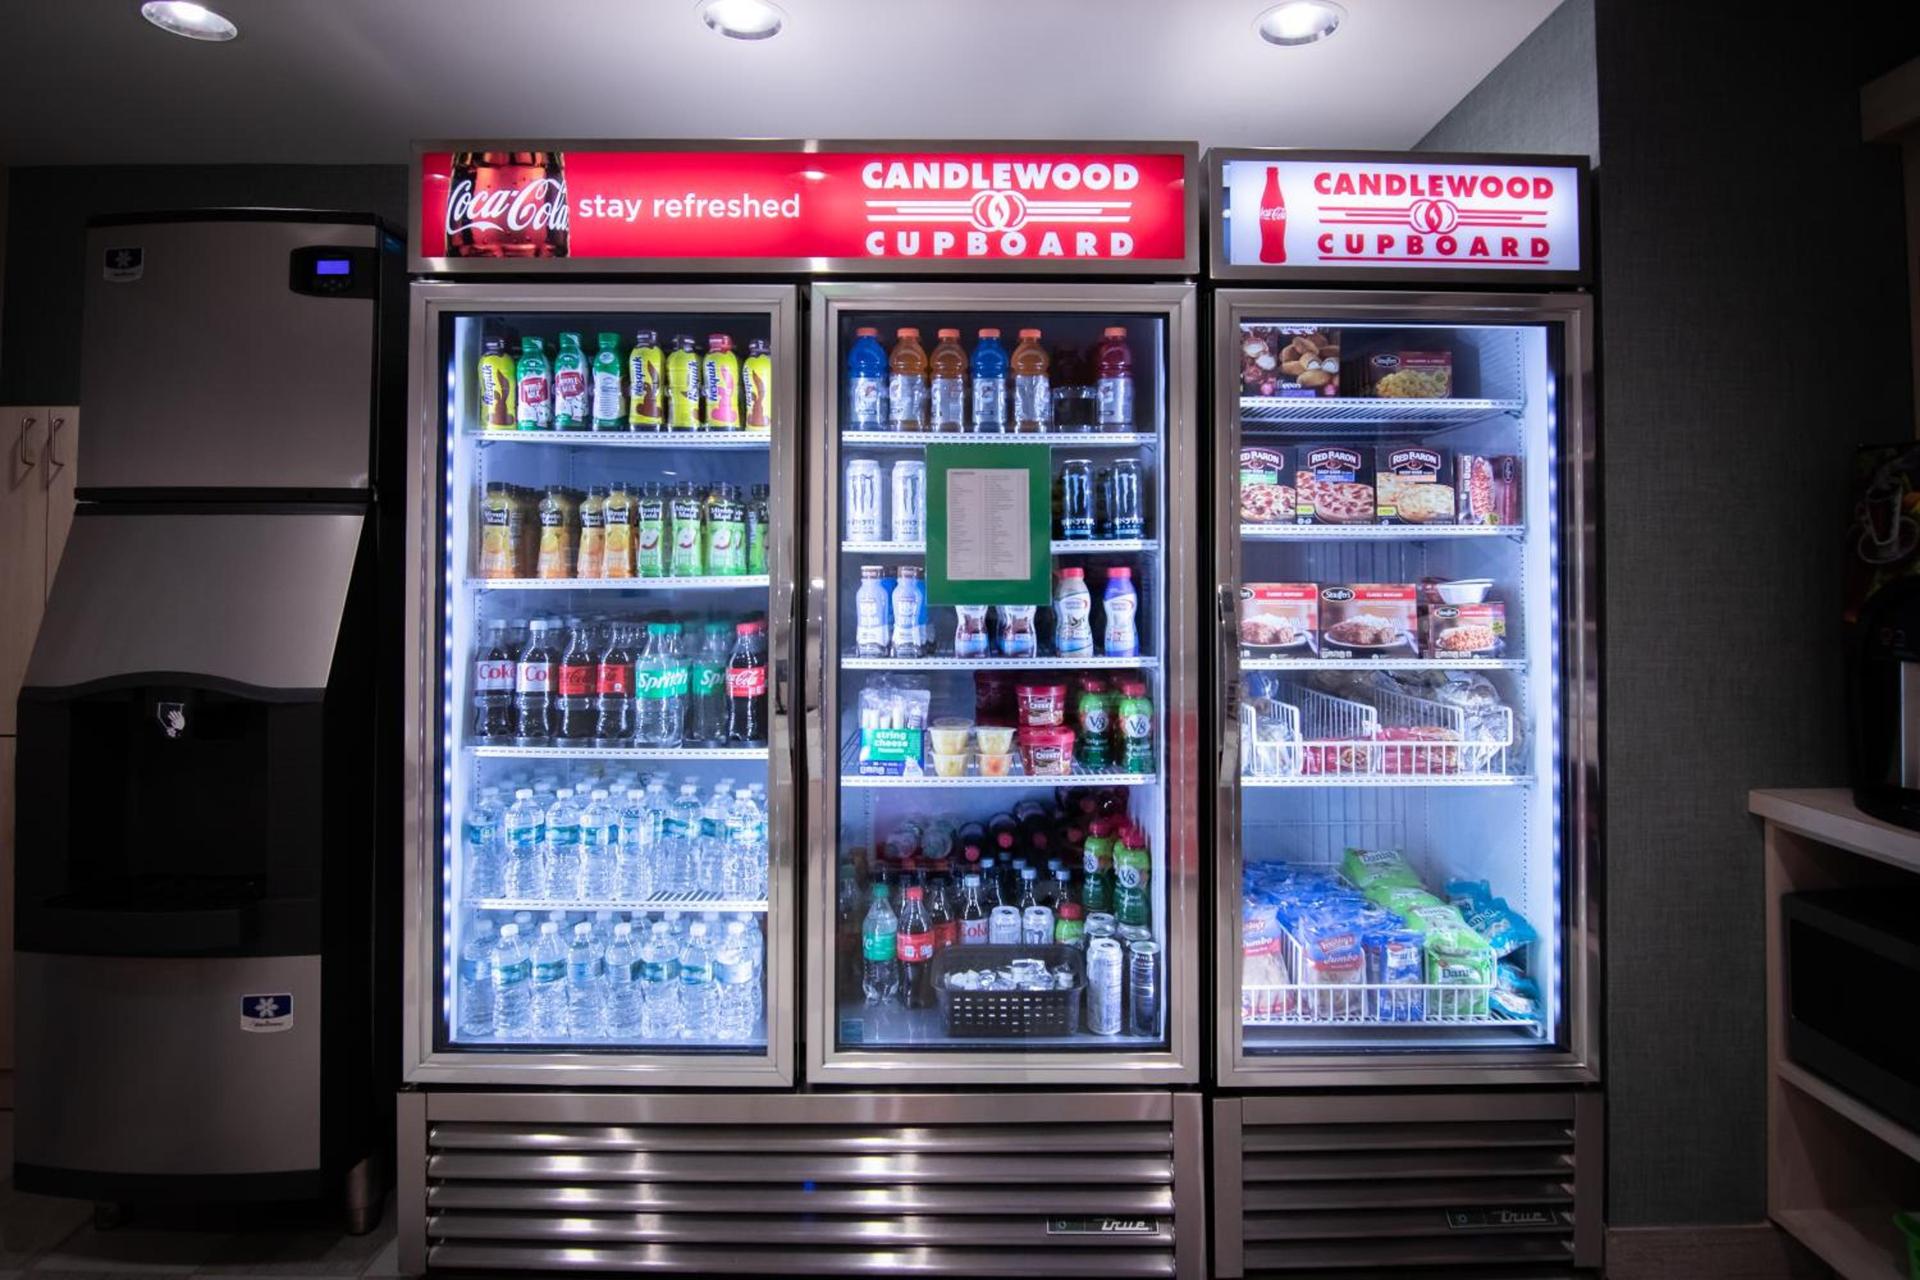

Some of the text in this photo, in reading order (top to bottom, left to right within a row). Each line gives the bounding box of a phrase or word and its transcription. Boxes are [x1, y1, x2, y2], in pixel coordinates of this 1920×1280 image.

[862, 162, 1139, 190] CANDLEWOOD
[1313, 172, 1554, 199] CANDLEWOOD
[445, 178, 569, 236] Coca-Cola
[579, 192, 800, 221] stay refreshed
[866, 230, 1134, 256] CUPBOARD
[1317, 233, 1550, 258] CUPBOARD
[632, 356, 646, 396] Nesquik
[706, 361, 720, 402] Nesquik
[1240, 451, 1279, 464] ED BARON
[1311, 451, 1356, 463] RED BARON
[1393, 451, 1437, 463] RED BARON
[525, 666, 547, 681] Co
[1089, 715, 1106, 730] V8
[1130, 719, 1146, 734] V8
[874, 740, 909, 748] cheese
[876, 730, 907, 741] string
[1121, 869, 1136, 885] V8
[1470, 908, 1498, 928] anish
